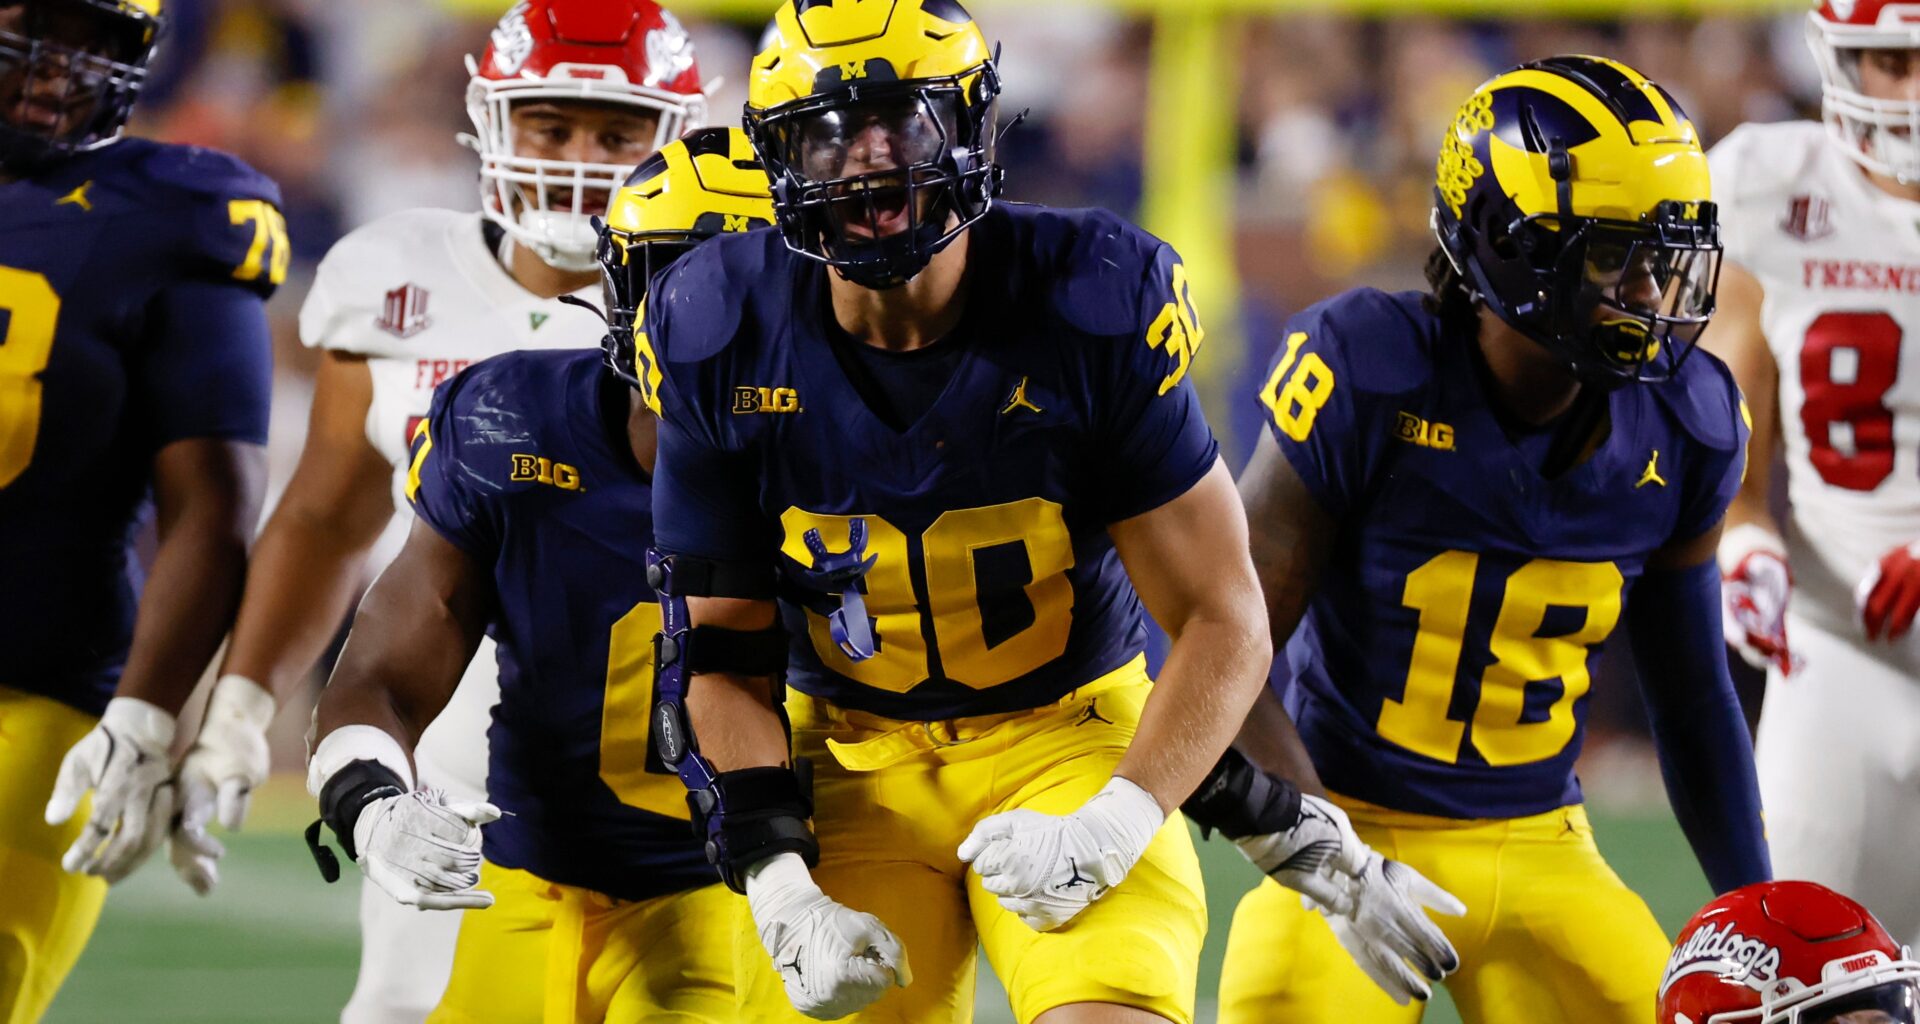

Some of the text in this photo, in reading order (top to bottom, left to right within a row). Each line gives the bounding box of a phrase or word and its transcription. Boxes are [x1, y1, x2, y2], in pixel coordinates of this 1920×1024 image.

[840, 60, 867, 80] M
[722, 214, 749, 232] M
[1146, 263, 1205, 396] 30
[1259, 332, 1335, 442] 18
[1799, 311, 1903, 492] 8
[780, 497, 1075, 693] 30
[1376, 549, 1624, 766] 18
[1668, 921, 1779, 981] ulldogs
